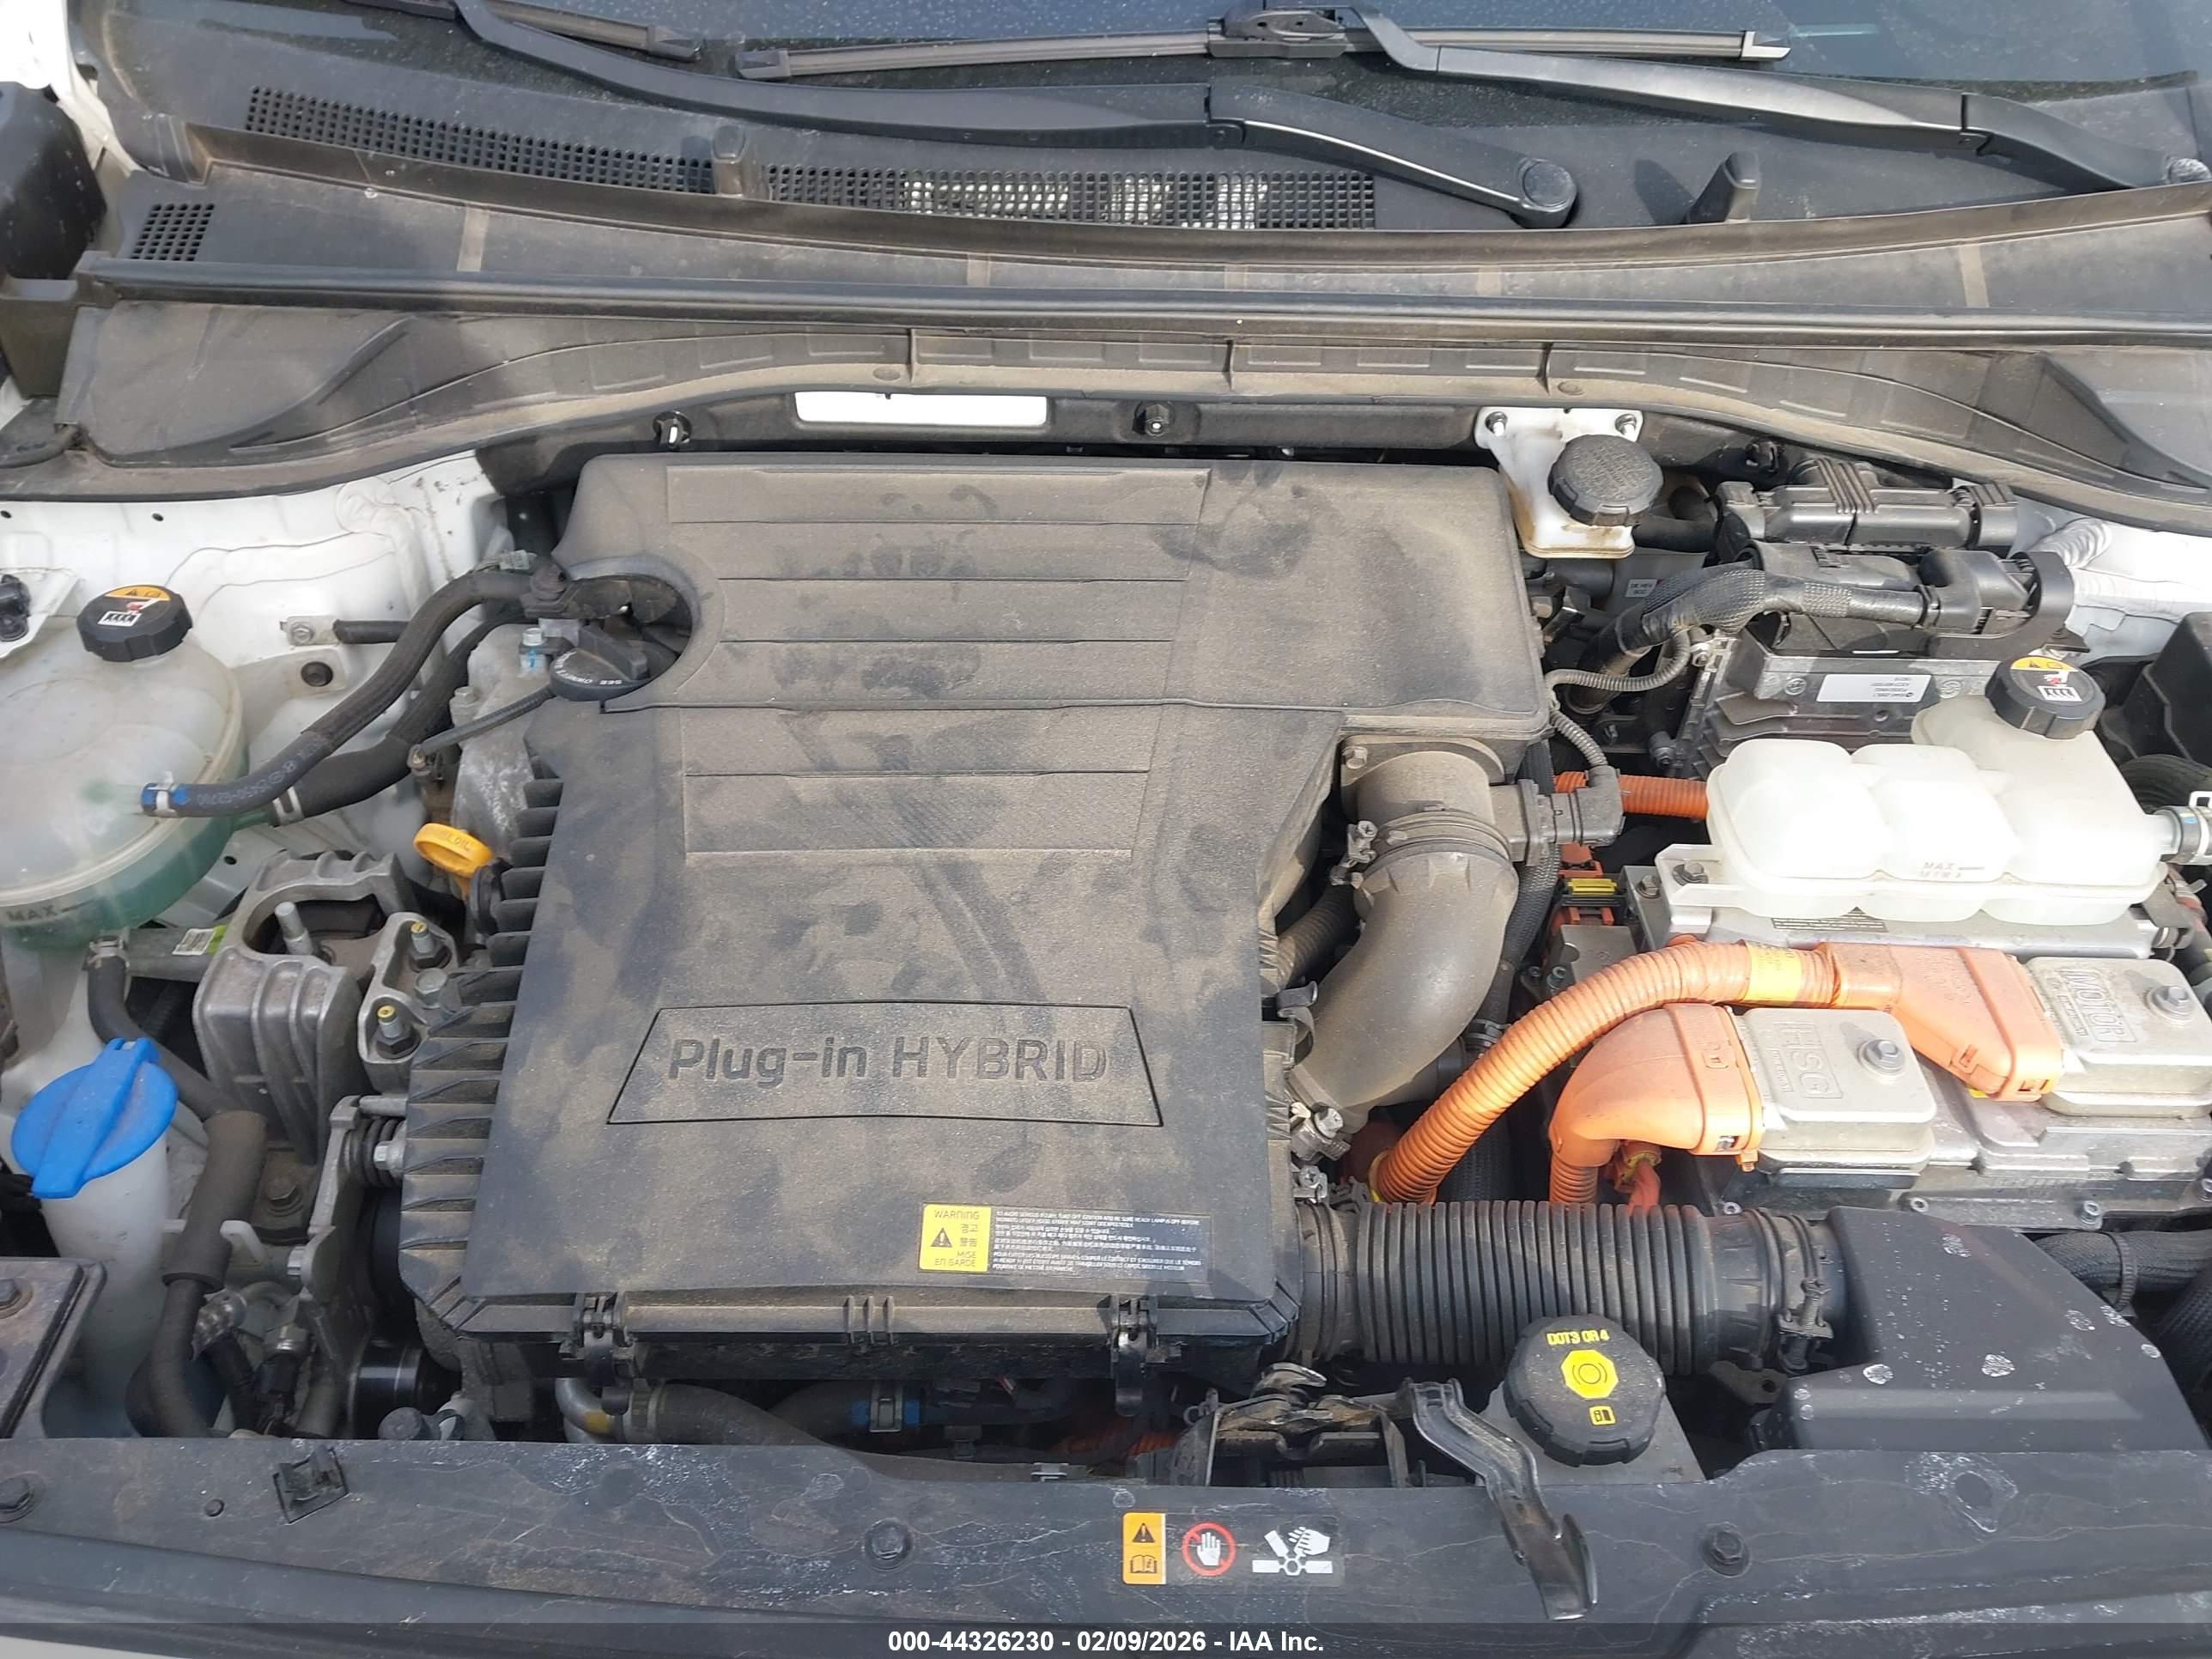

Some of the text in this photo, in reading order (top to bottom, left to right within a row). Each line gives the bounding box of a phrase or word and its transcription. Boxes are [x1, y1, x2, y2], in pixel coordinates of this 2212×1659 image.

[6, 904, 57, 921] MAX
[2064, 972, 2126, 1037] MOTOR
[668, 1036, 1108, 1089] Plug-in HYBRID
[934, 1209, 980, 1220] WARNING
[957, 1250, 976, 1259] MISE
[950, 1258, 976, 1267] GARDE
[1581, 1330, 1600, 1342] OR
[1600, 1329, 1610, 1340] 4
